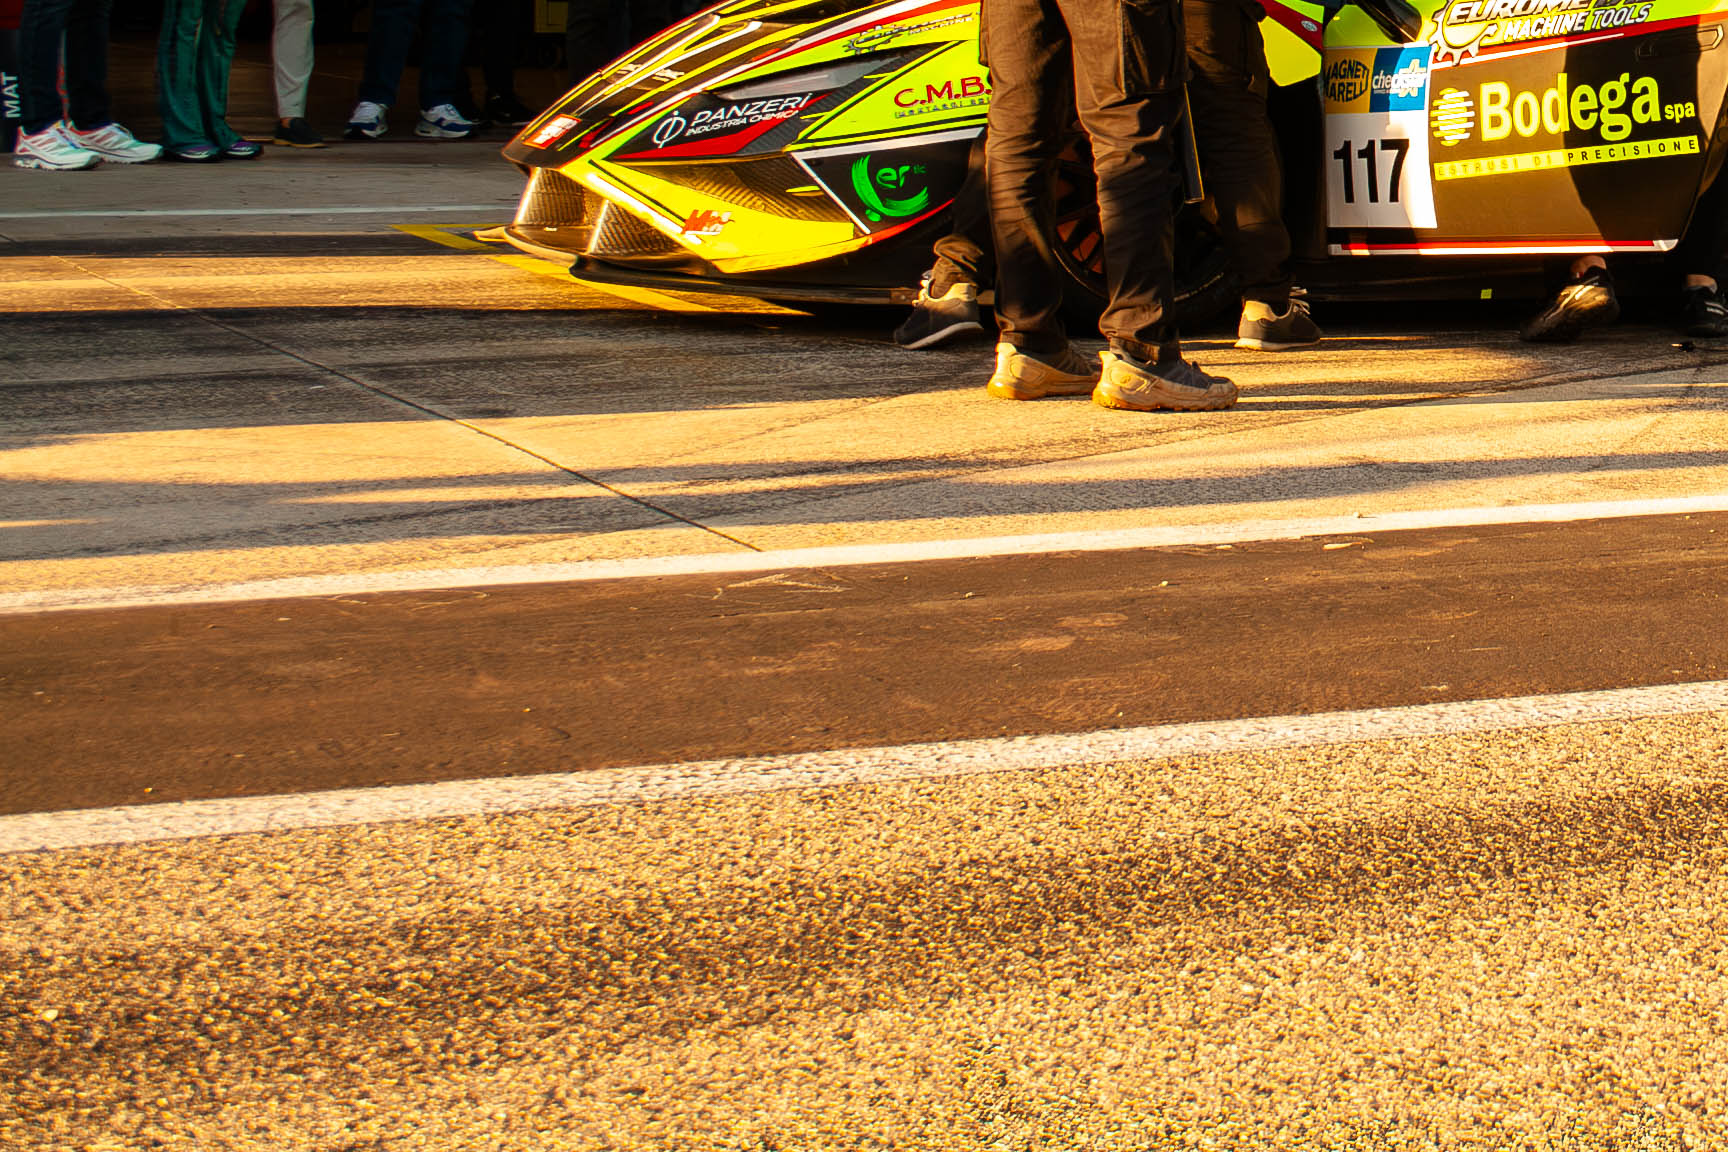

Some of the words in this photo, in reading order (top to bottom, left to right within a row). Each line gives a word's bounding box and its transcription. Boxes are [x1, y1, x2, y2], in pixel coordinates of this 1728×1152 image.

[1503, 11, 1589, 40] MACHINE
[1591, 3, 1653, 30] TOOLS
[0, 71, 21, 118] MAT
[1479, 72, 1662, 142] Bodega
[1664, 102, 1696, 124] spa
[685, 116, 747, 137] INDUSTRIA
[1333, 138, 1410, 204] 117
[1437, 157, 1519, 177] ESTRUSI
[1533, 154, 1553, 168] DI
[1567, 138, 1696, 163] PRECISIONE
